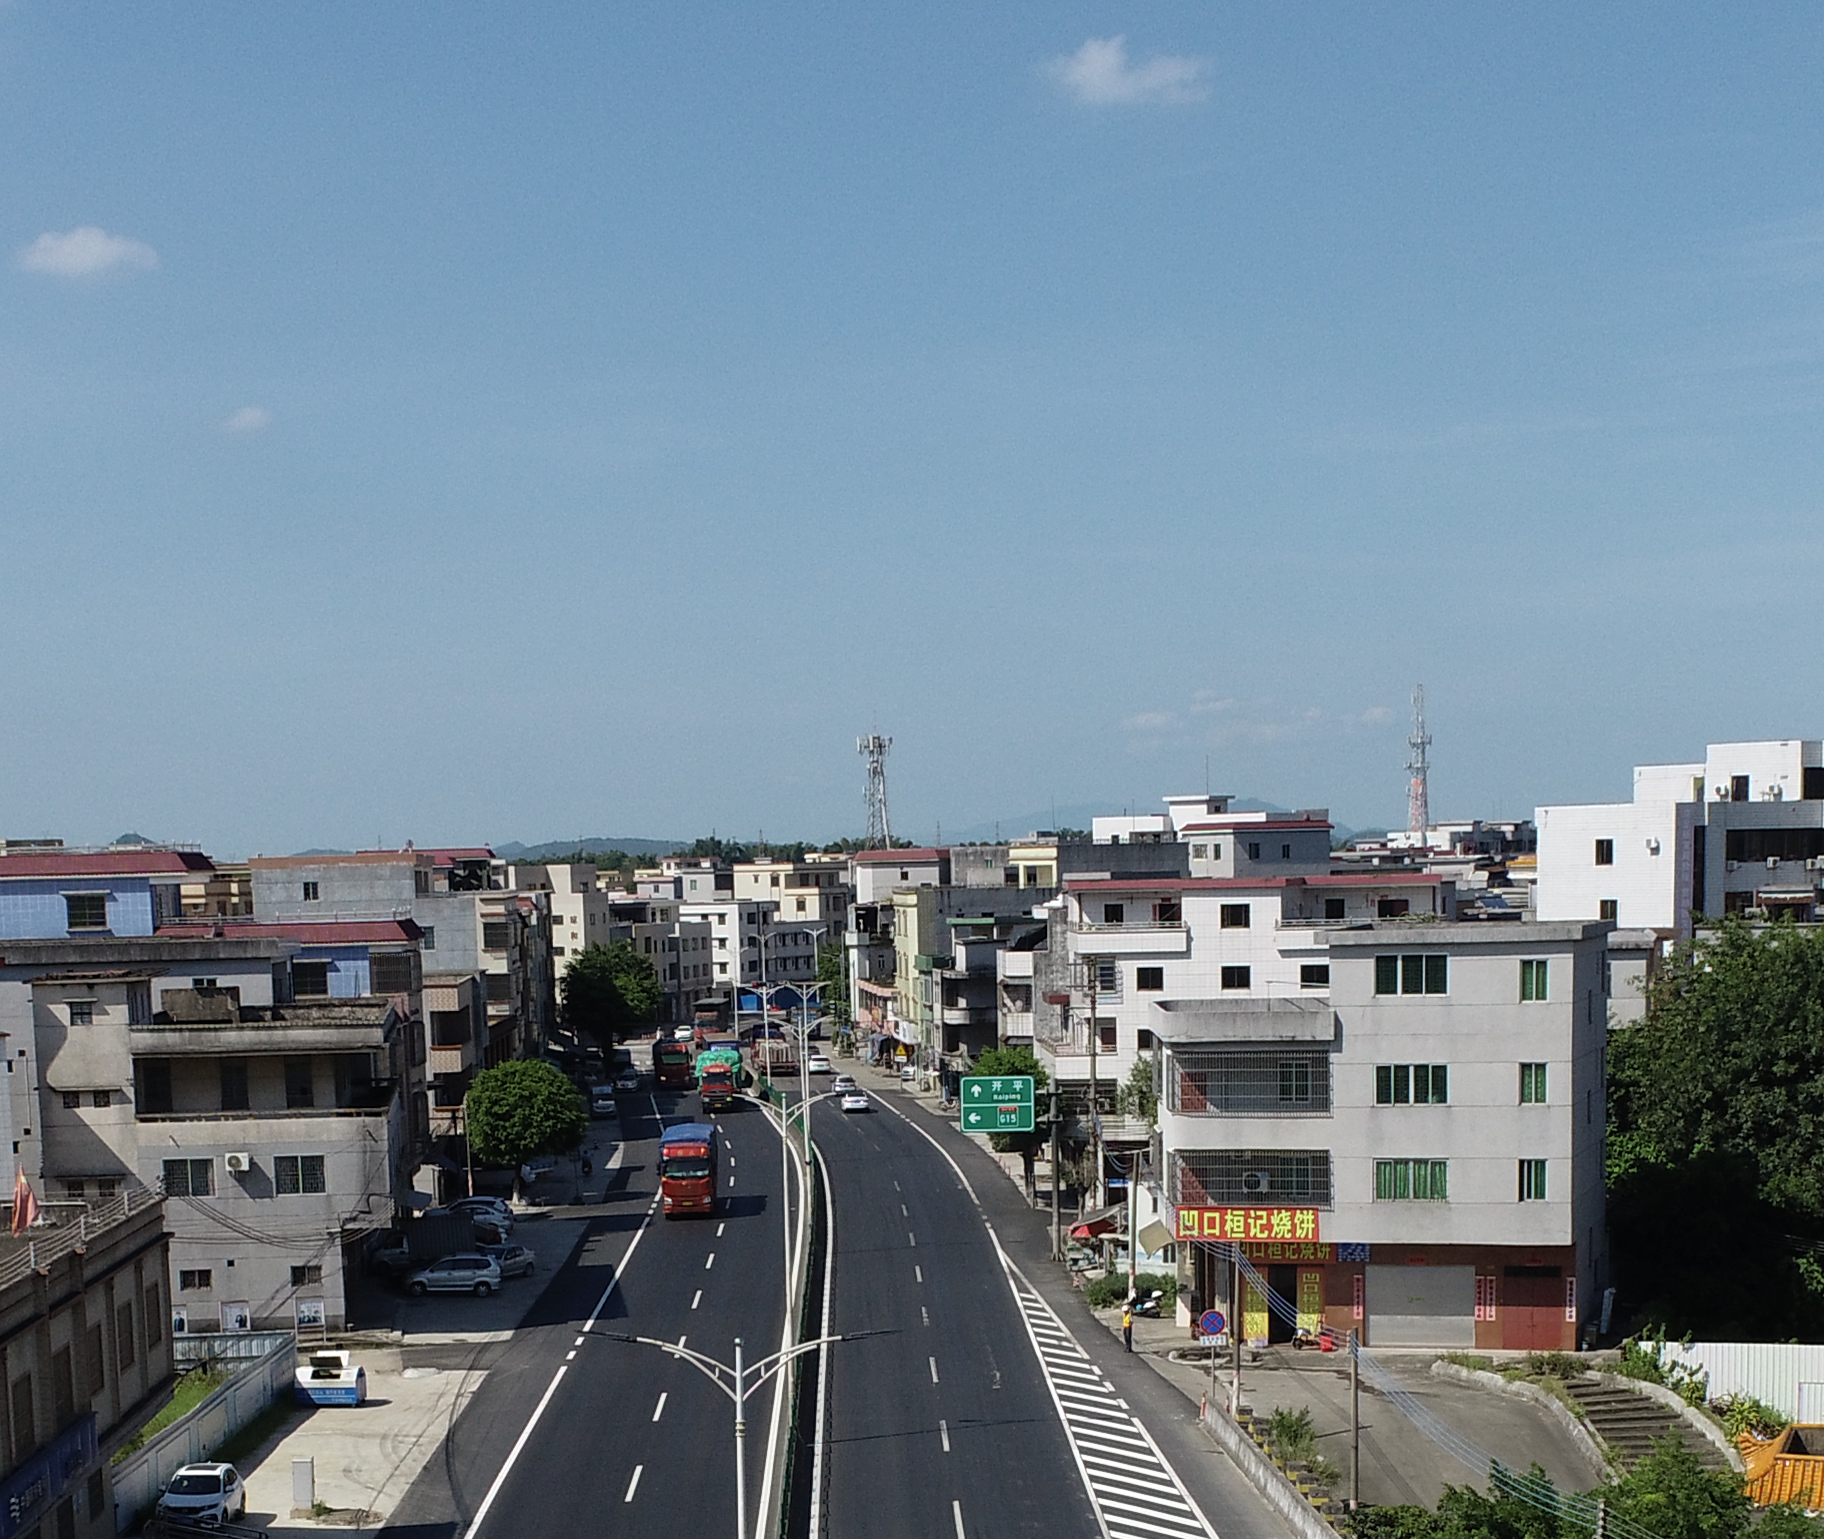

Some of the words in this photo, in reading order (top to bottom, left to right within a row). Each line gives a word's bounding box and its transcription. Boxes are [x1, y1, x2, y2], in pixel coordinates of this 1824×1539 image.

[991, 1080, 1024, 1092] 开平
[999, 1113, 1017, 1124] G15
[1179, 1208, 1316, 1239] 凹口桓记烧饼
